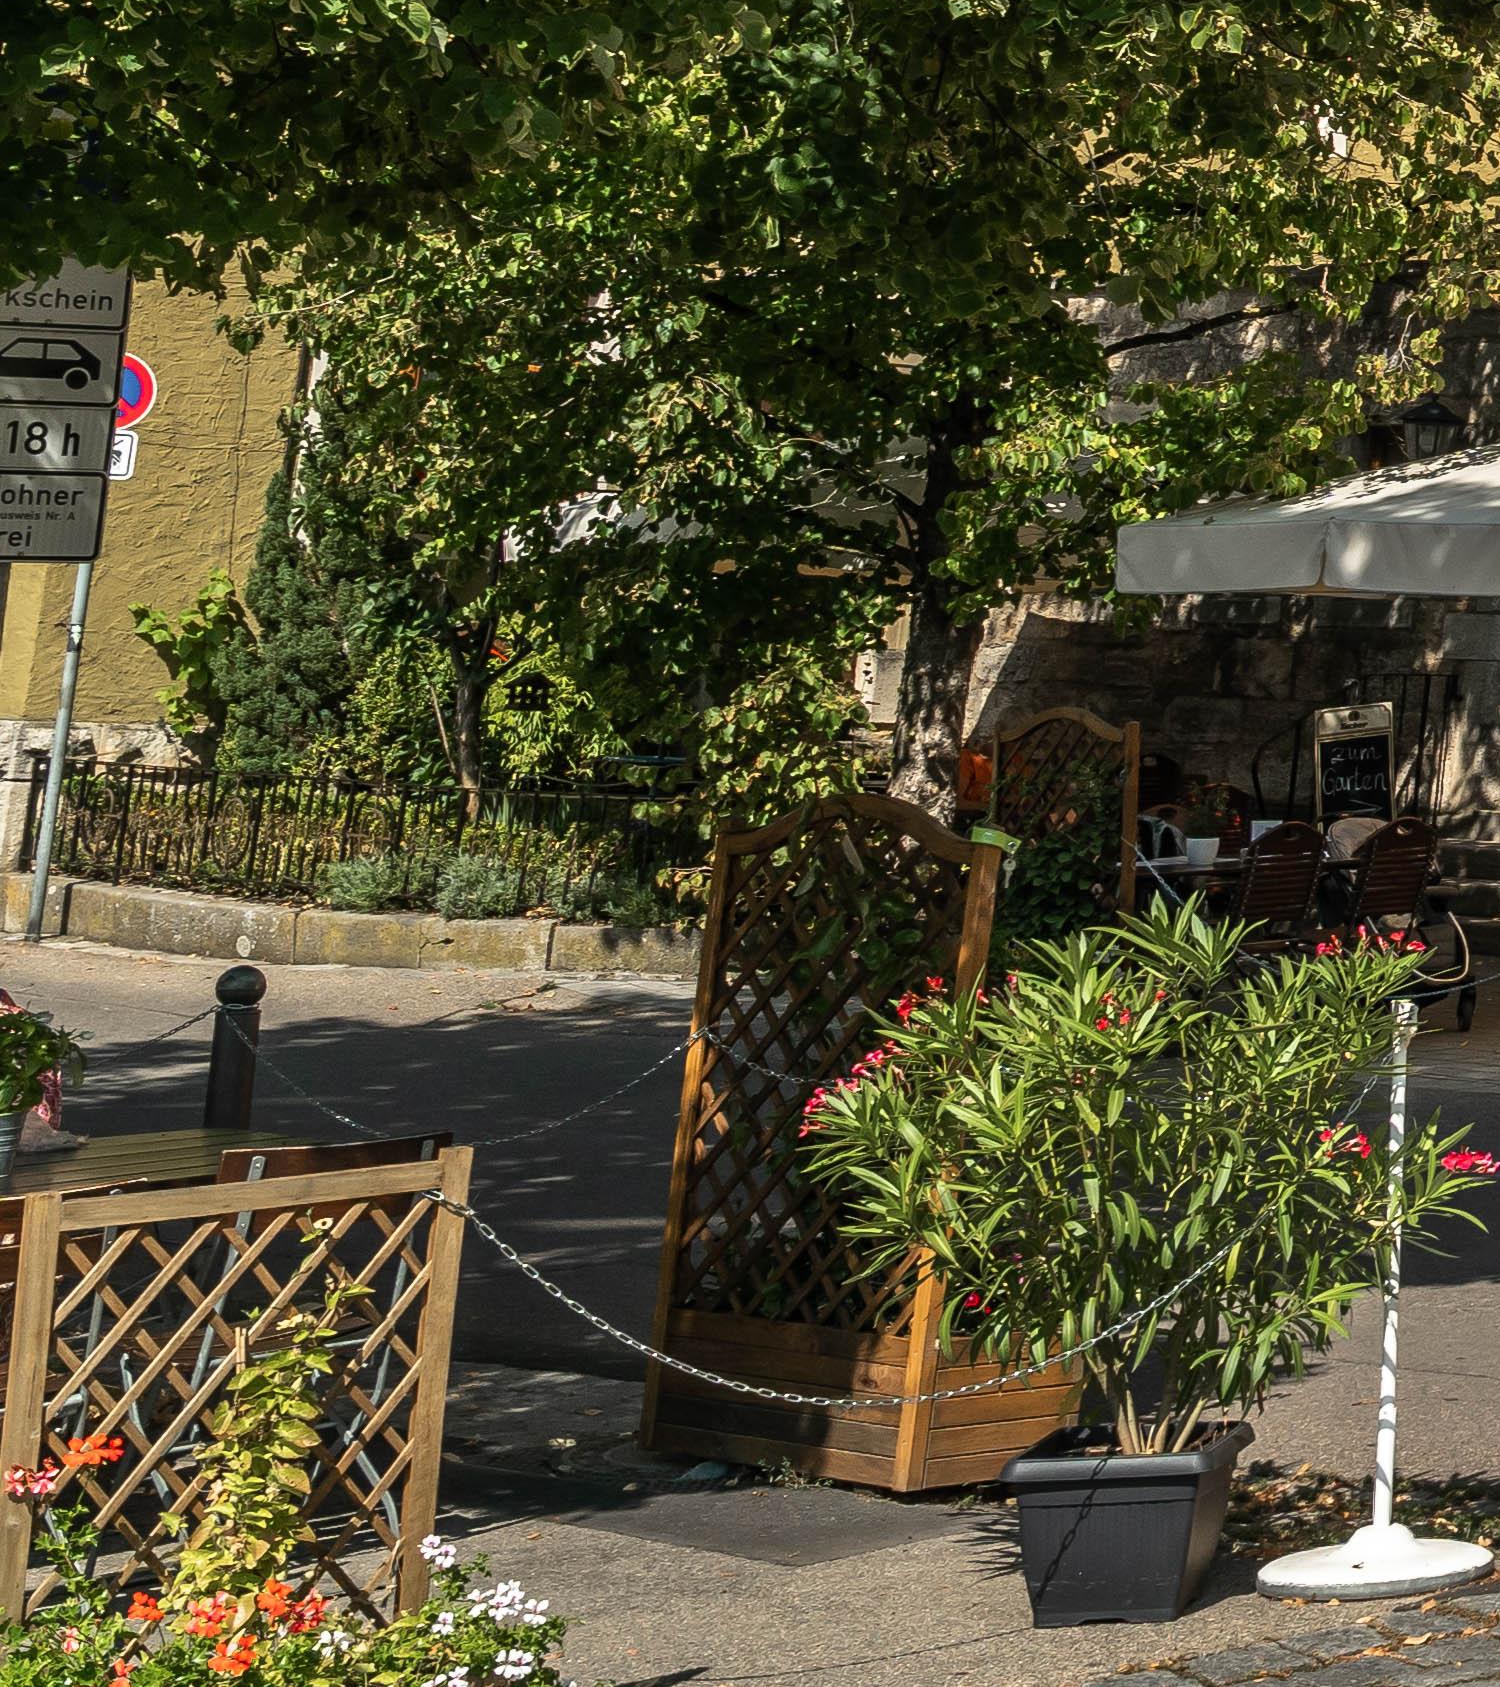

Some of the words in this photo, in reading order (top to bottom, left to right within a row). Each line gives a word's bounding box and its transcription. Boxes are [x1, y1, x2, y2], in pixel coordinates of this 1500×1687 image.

[6, 420, 49, 456] 18
[61, 422, 80, 457] h
[0, 483, 84, 506] ohner
